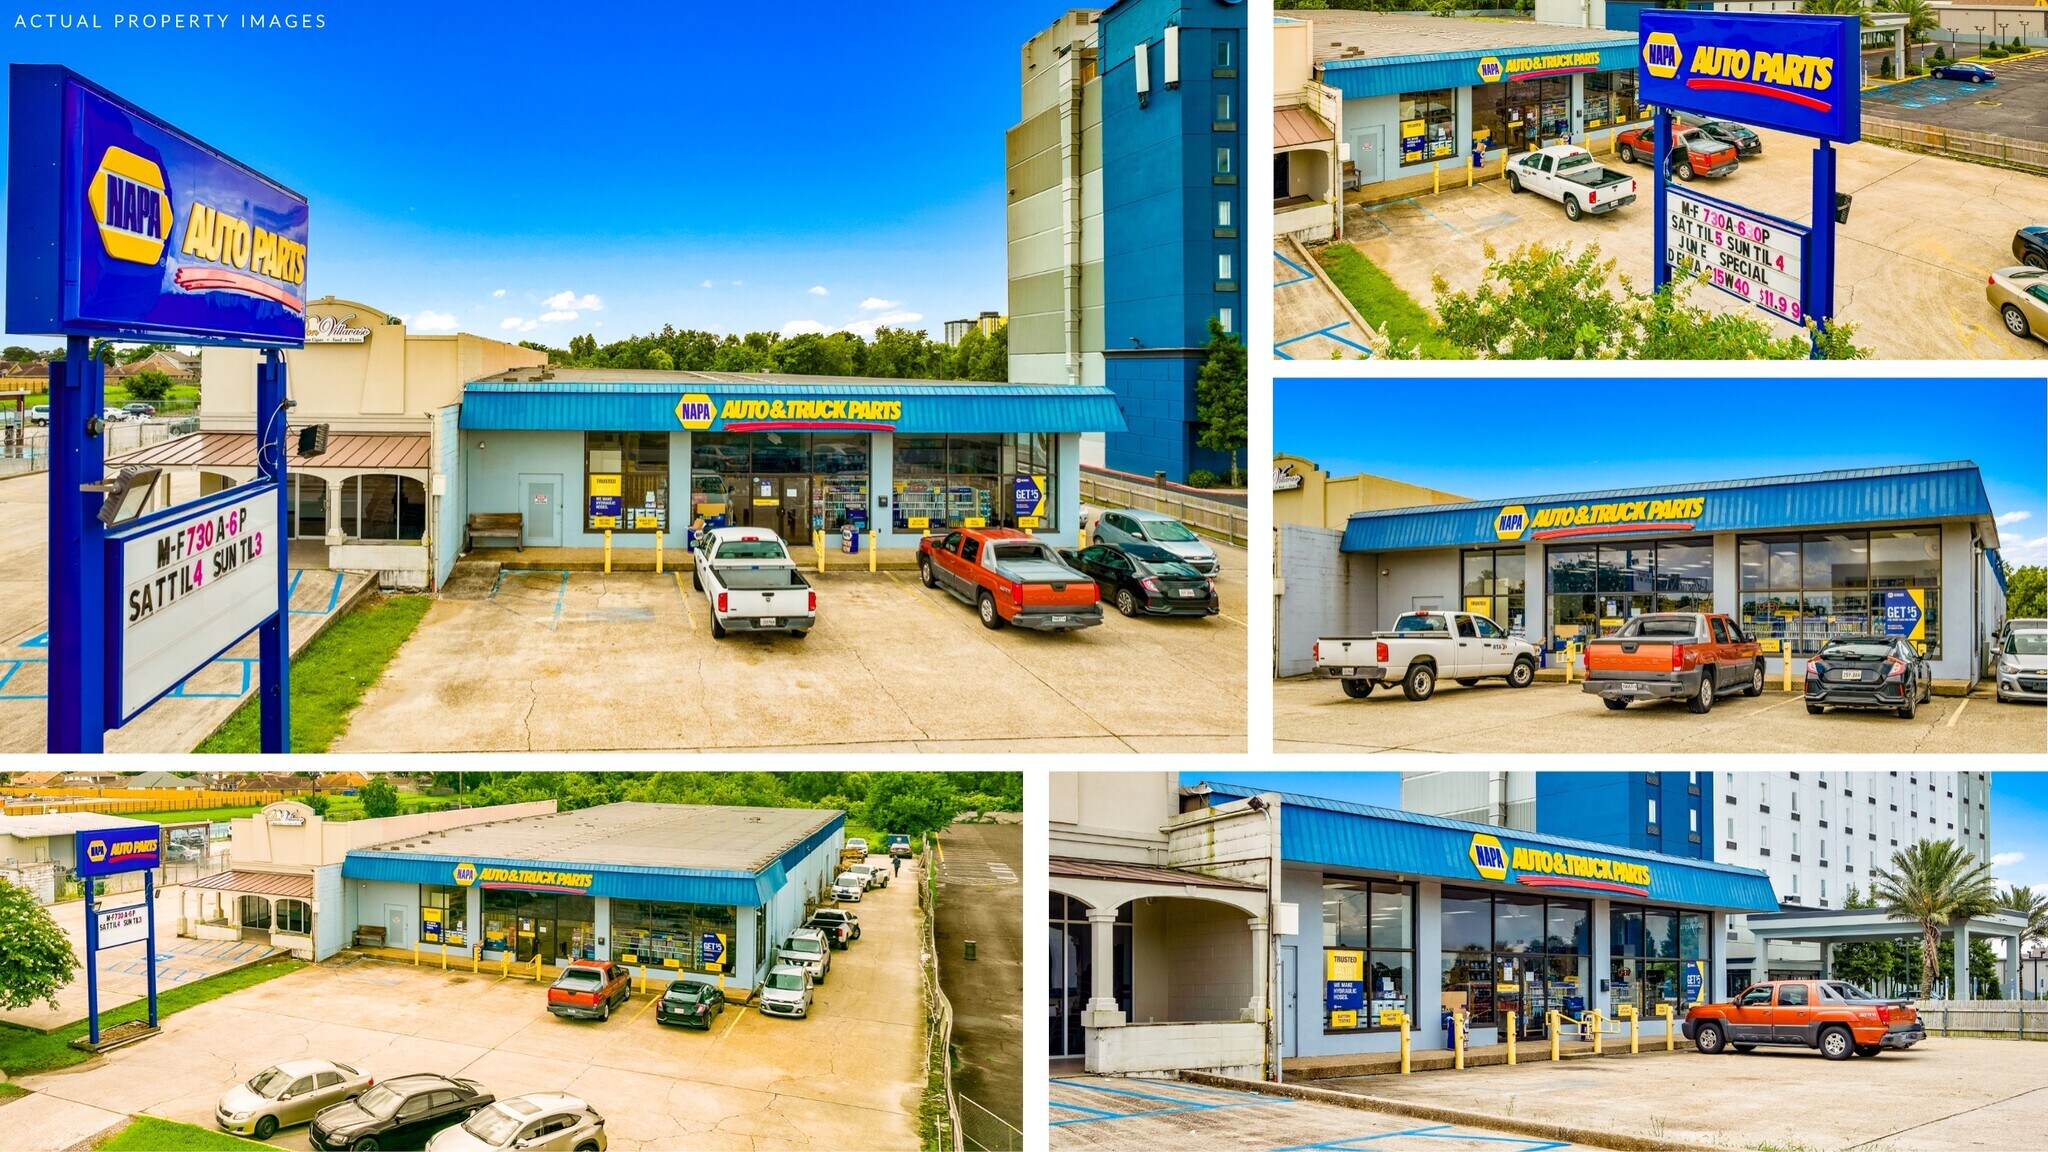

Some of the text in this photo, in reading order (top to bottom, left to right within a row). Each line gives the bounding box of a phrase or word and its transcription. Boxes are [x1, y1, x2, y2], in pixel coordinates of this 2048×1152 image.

[1573, 51, 1600, 65] PARTS
[1649, 43, 1675, 68] NAPA
[1481, 63, 1500, 76] NAPA
[1690, 46, 1834, 91] AUTO PARTS
[107, 173, 162, 240] NAPA
[1682, 200, 1699, 218] M-F
[182, 202, 306, 286] AUTO PARTS
[1672, 215, 1693, 235] SAT
[1727, 236, 1750, 259] SUN
[1679, 236, 1768, 285] JUNE SPECIAL
[682, 402, 711, 420] NAPA
[847, 400, 902, 420] PARTS
[1016, 489, 1039, 500] GET $5
[1647, 497, 1705, 521] PARTS
[1499, 514, 1523, 531] NAPA
[213, 543, 237, 578] SUN
[1887, 606, 1917, 618] GET $5
[91, 845, 104, 856] NAPA
[110, 839, 158, 856] AUTO PARTS
[1475, 844, 1504, 869] NAPA
[456, 868, 473, 880] NAPA
[556, 871, 593, 888] PARTS
[1611, 860, 1651, 886] PARTS
[704, 942, 716, 950] GET
